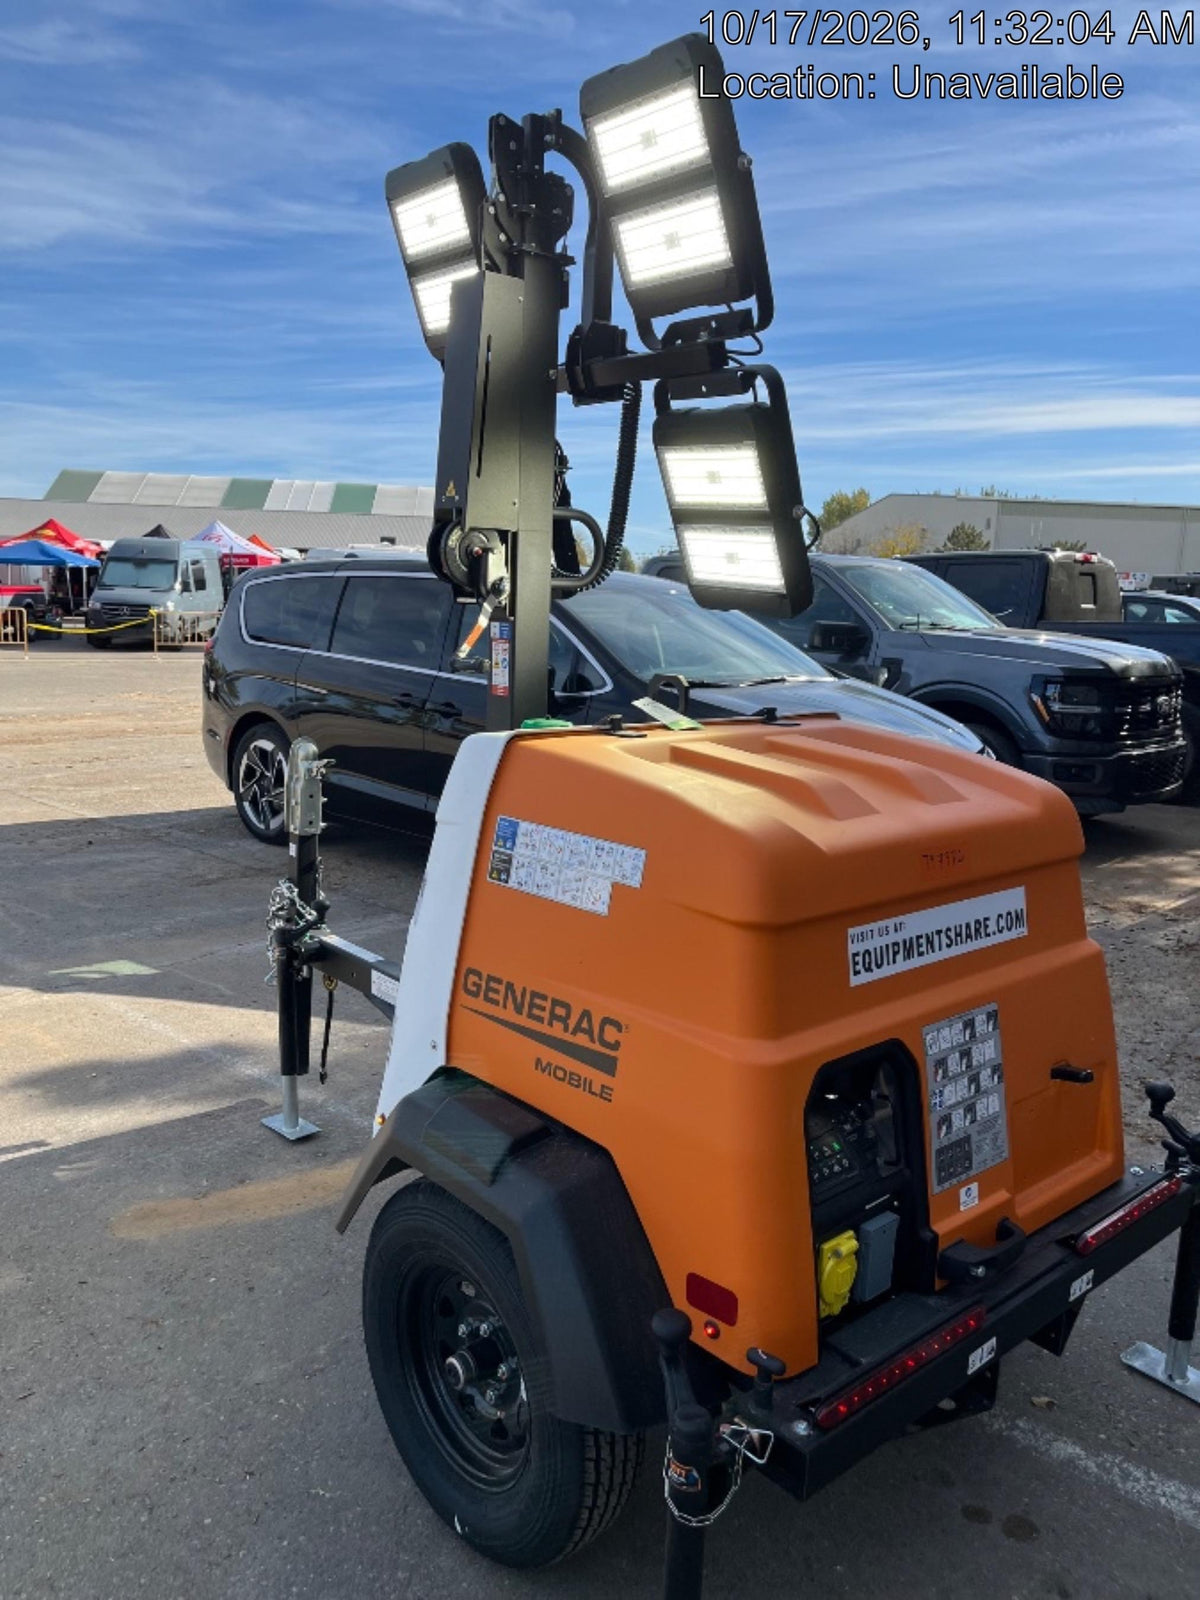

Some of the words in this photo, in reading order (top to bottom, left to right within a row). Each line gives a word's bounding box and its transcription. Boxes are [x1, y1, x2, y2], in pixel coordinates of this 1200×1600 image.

[850, 929, 874, 944] VISIT
[878, 925, 890, 937] US
[852, 908, 1025, 976] EQUIPMENTSHARE.COM
[462, 966, 622, 1051] GENERAC
[534, 1057, 614, 1102] MOBILE
